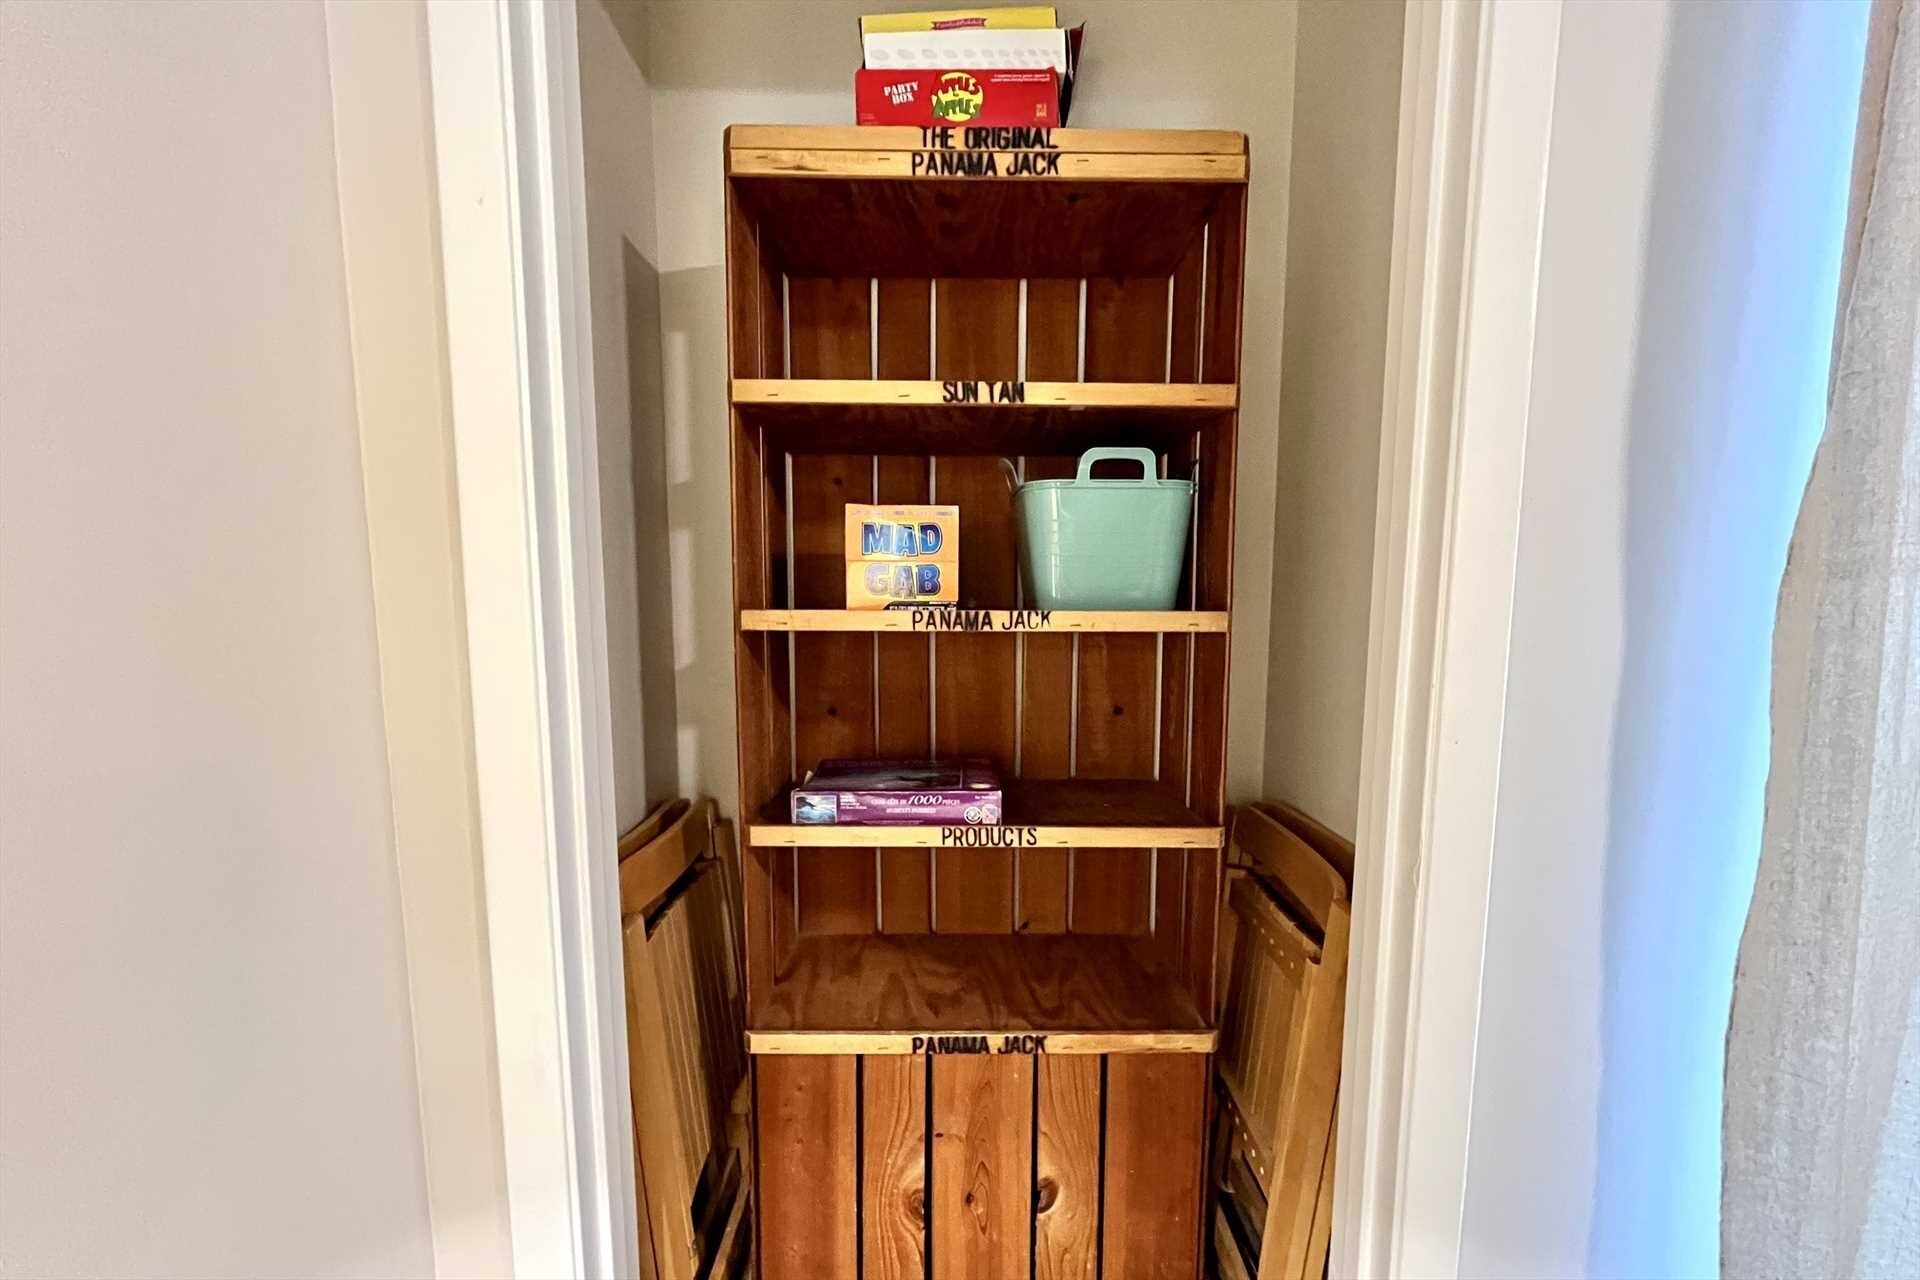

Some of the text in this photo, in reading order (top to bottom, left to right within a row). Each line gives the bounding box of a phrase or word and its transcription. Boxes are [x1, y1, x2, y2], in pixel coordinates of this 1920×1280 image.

[884, 81, 919, 97] PARTY
[892, 92, 914, 105] BOX
[932, 97, 982, 119] APPLES
[920, 127, 1058, 149] THE ORIGINAL
[912, 152, 1060, 176] PANAMA JACK
[942, 381, 1025, 403] SUN TAN
[861, 522, 943, 557] MAD
[864, 563, 942, 599] GAB
[912, 610, 1052, 630] PANAMA JACK
[907, 795, 943, 806] 1000
[942, 827, 1038, 847] PRODUCTS
[912, 1035, 1048, 1054] PANAMA JACK
